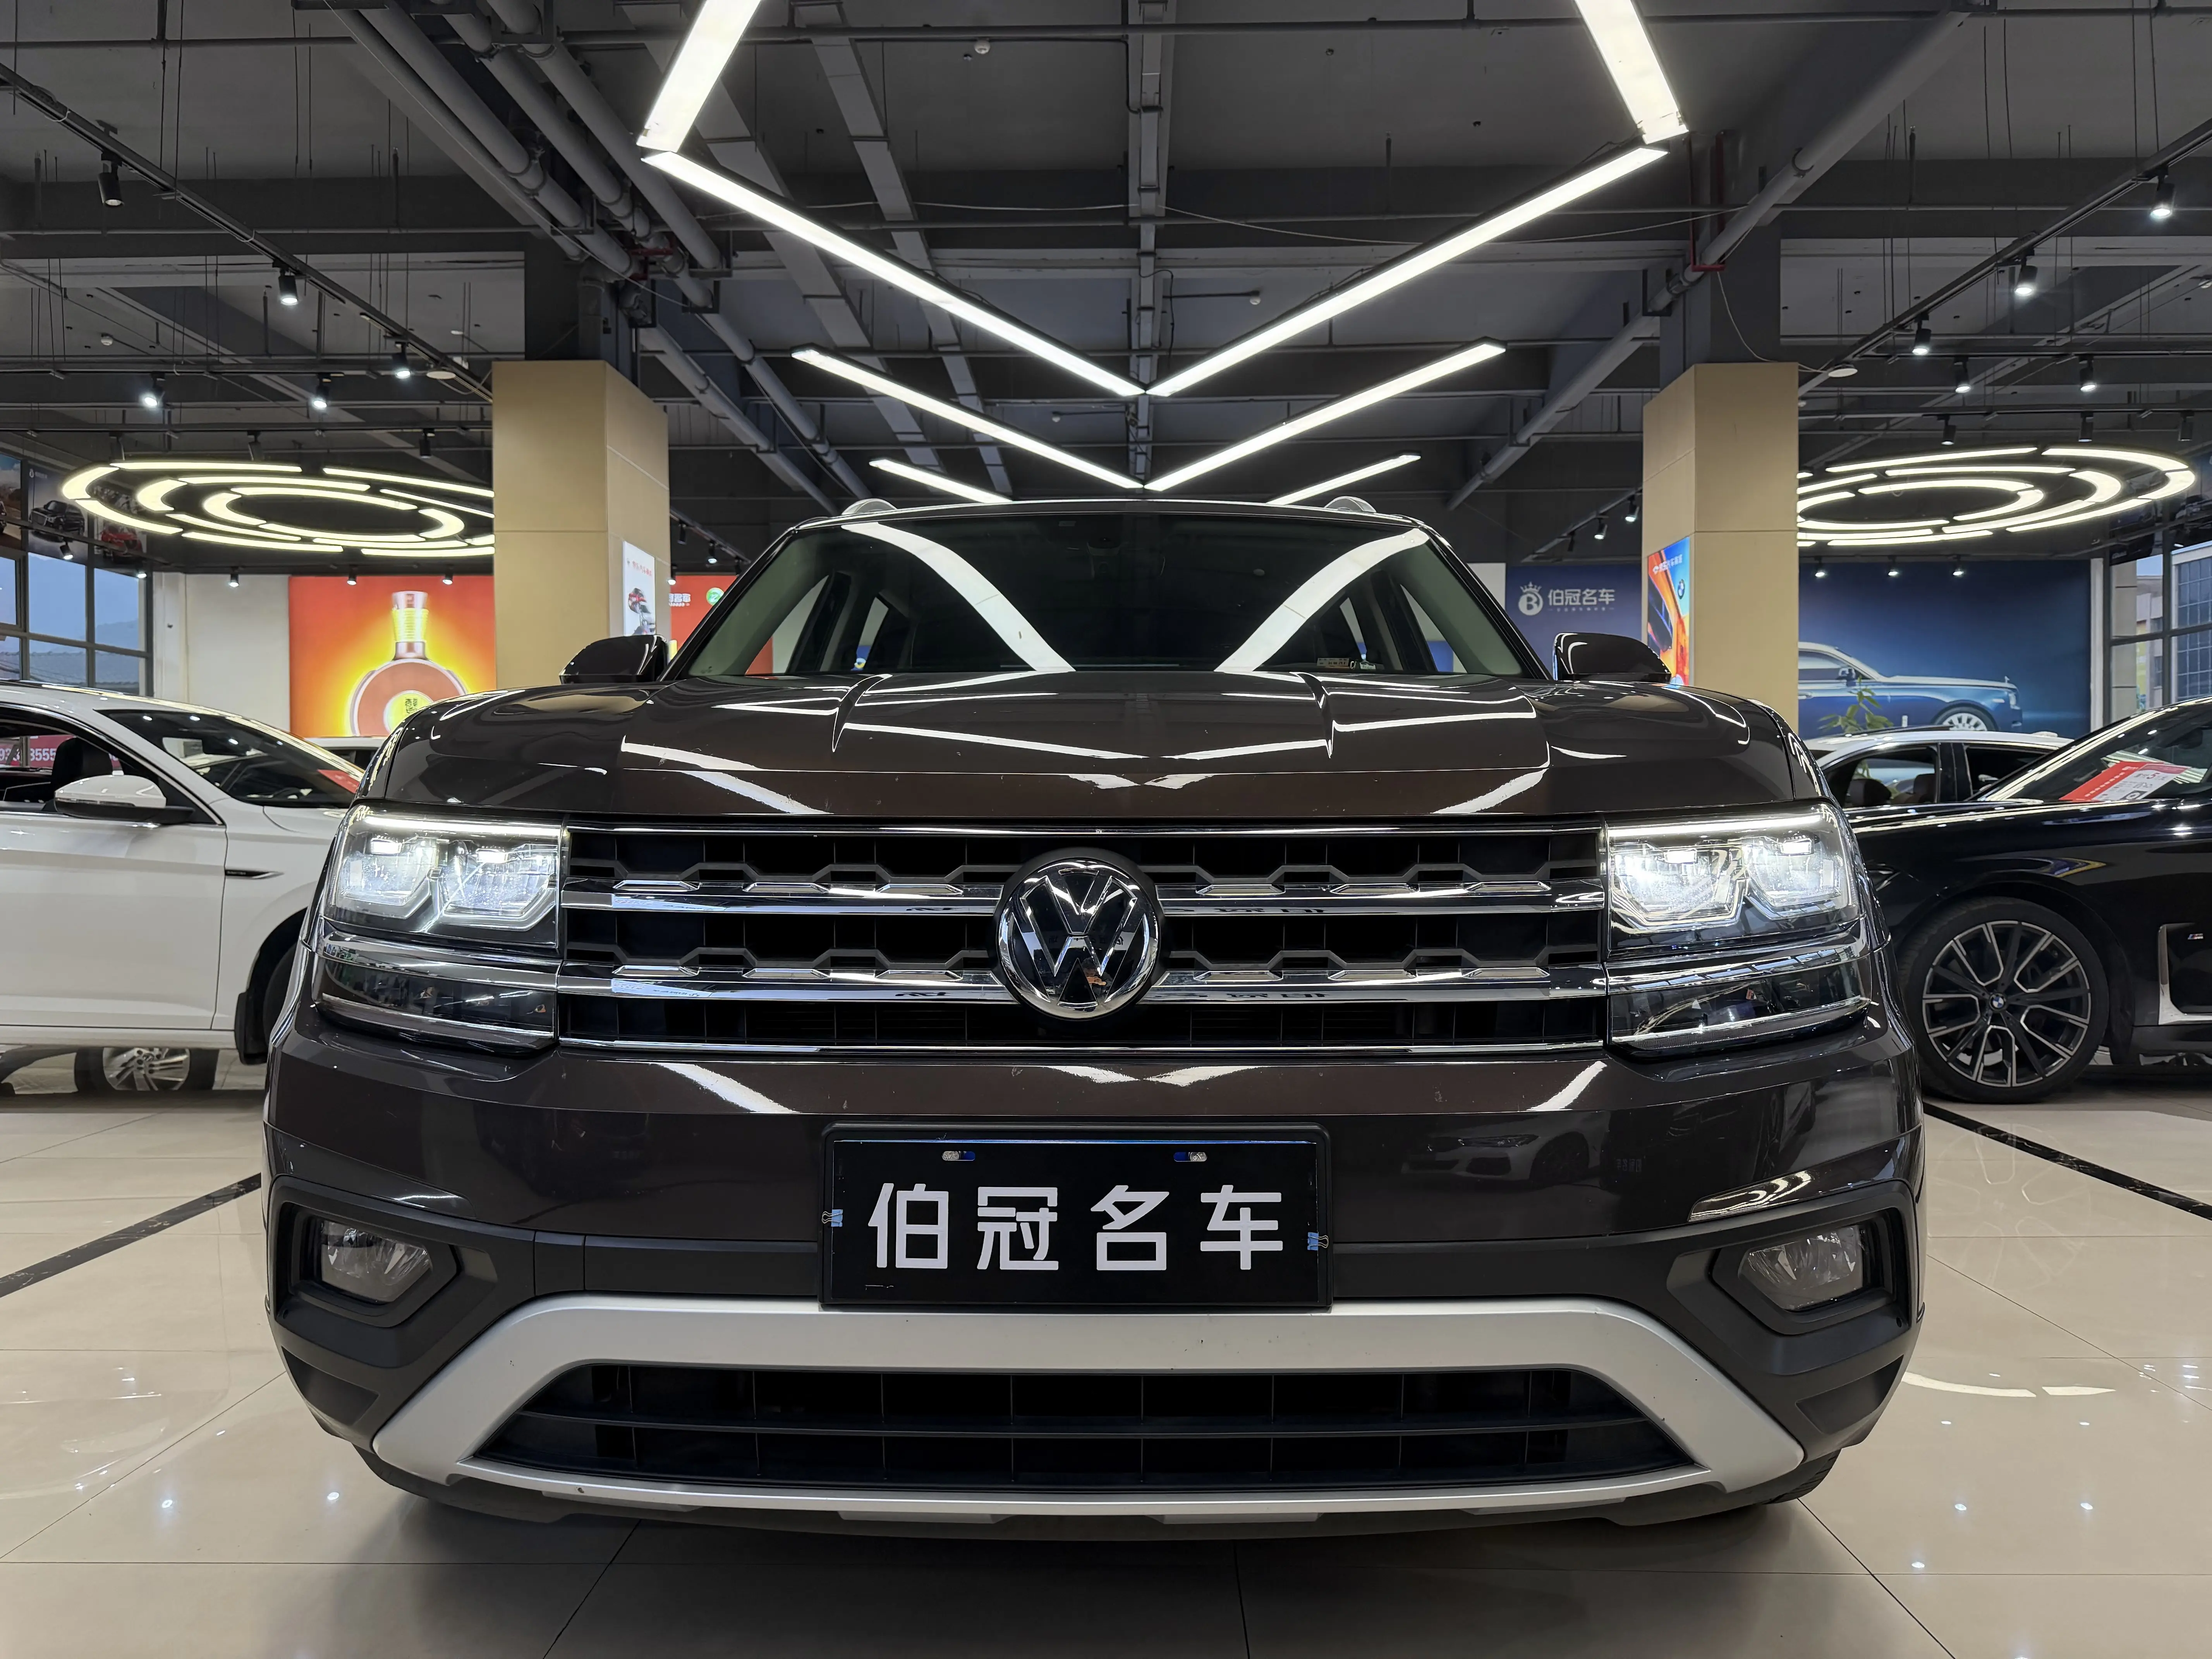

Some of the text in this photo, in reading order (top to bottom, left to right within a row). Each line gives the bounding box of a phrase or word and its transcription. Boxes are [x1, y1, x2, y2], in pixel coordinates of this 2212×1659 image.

[1548, 588, 1615, 606] 伯冠名车
[868, 1183, 1283, 1270] 伯冠名车
